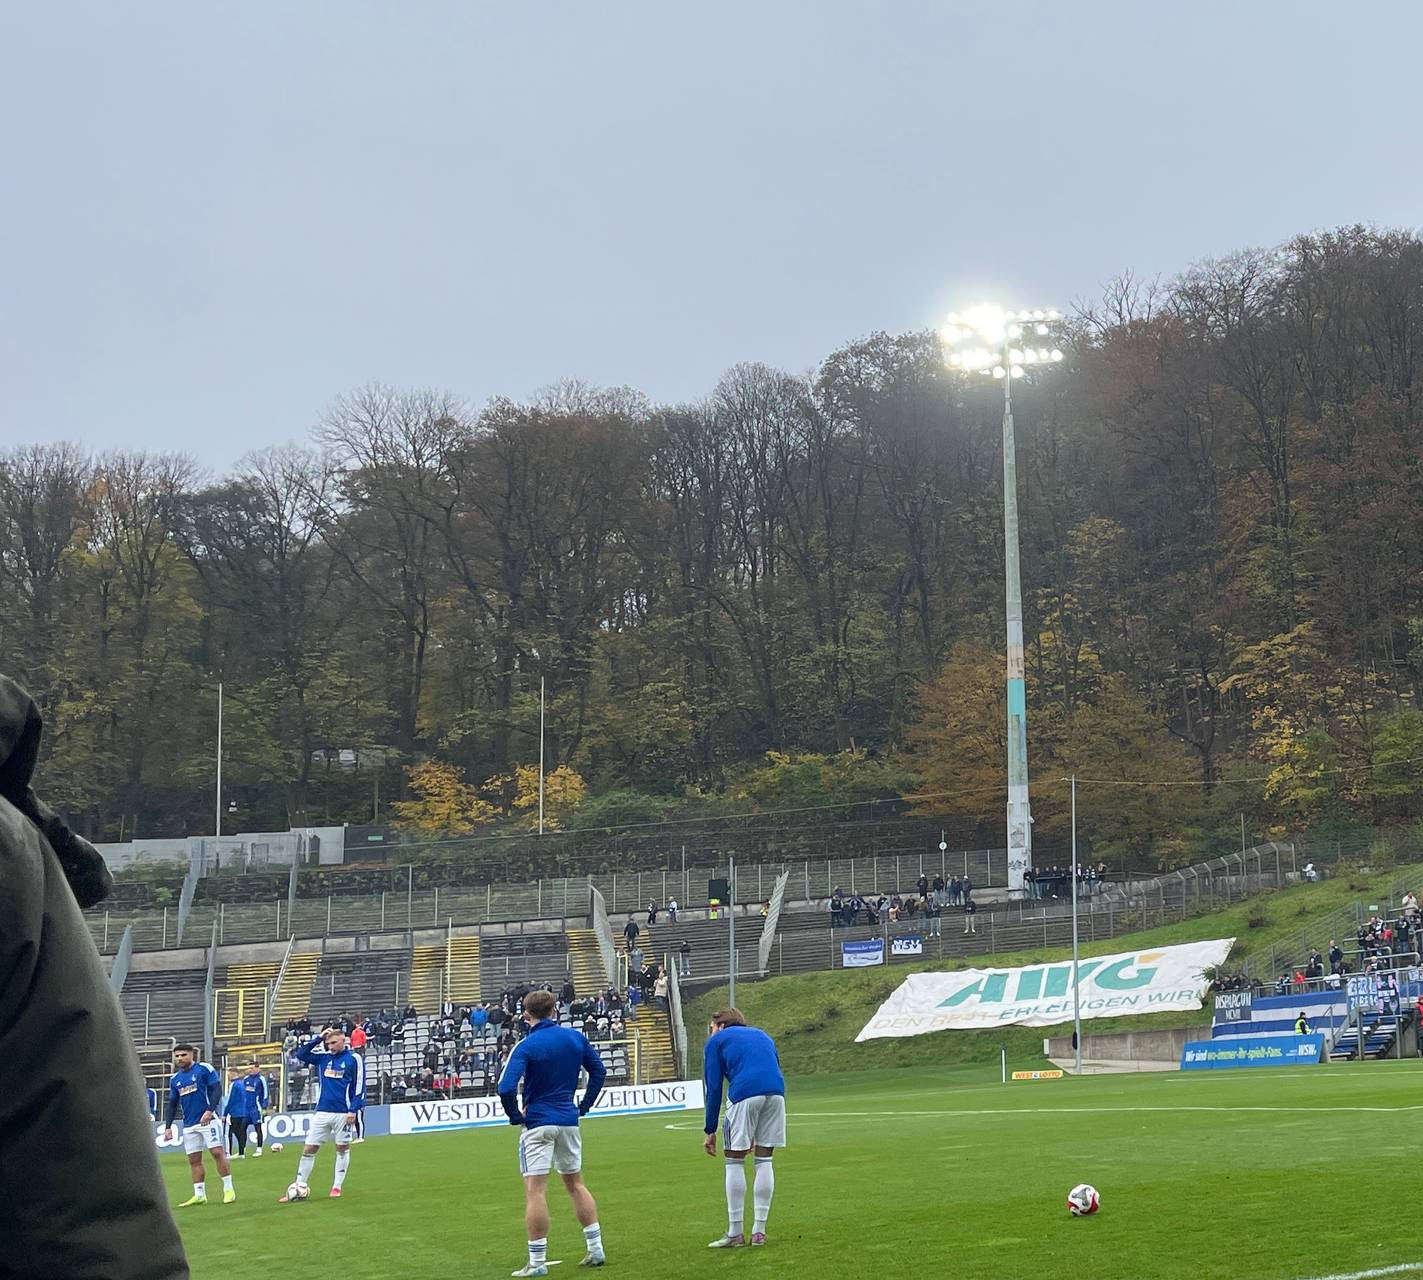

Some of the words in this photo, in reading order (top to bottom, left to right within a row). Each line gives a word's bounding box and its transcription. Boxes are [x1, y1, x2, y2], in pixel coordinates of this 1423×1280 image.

[936, 954, 1162, 1009] AWG
[1195, 1050, 1207, 1061] sind
[595, 1086, 687, 1109] ZEITUNG
